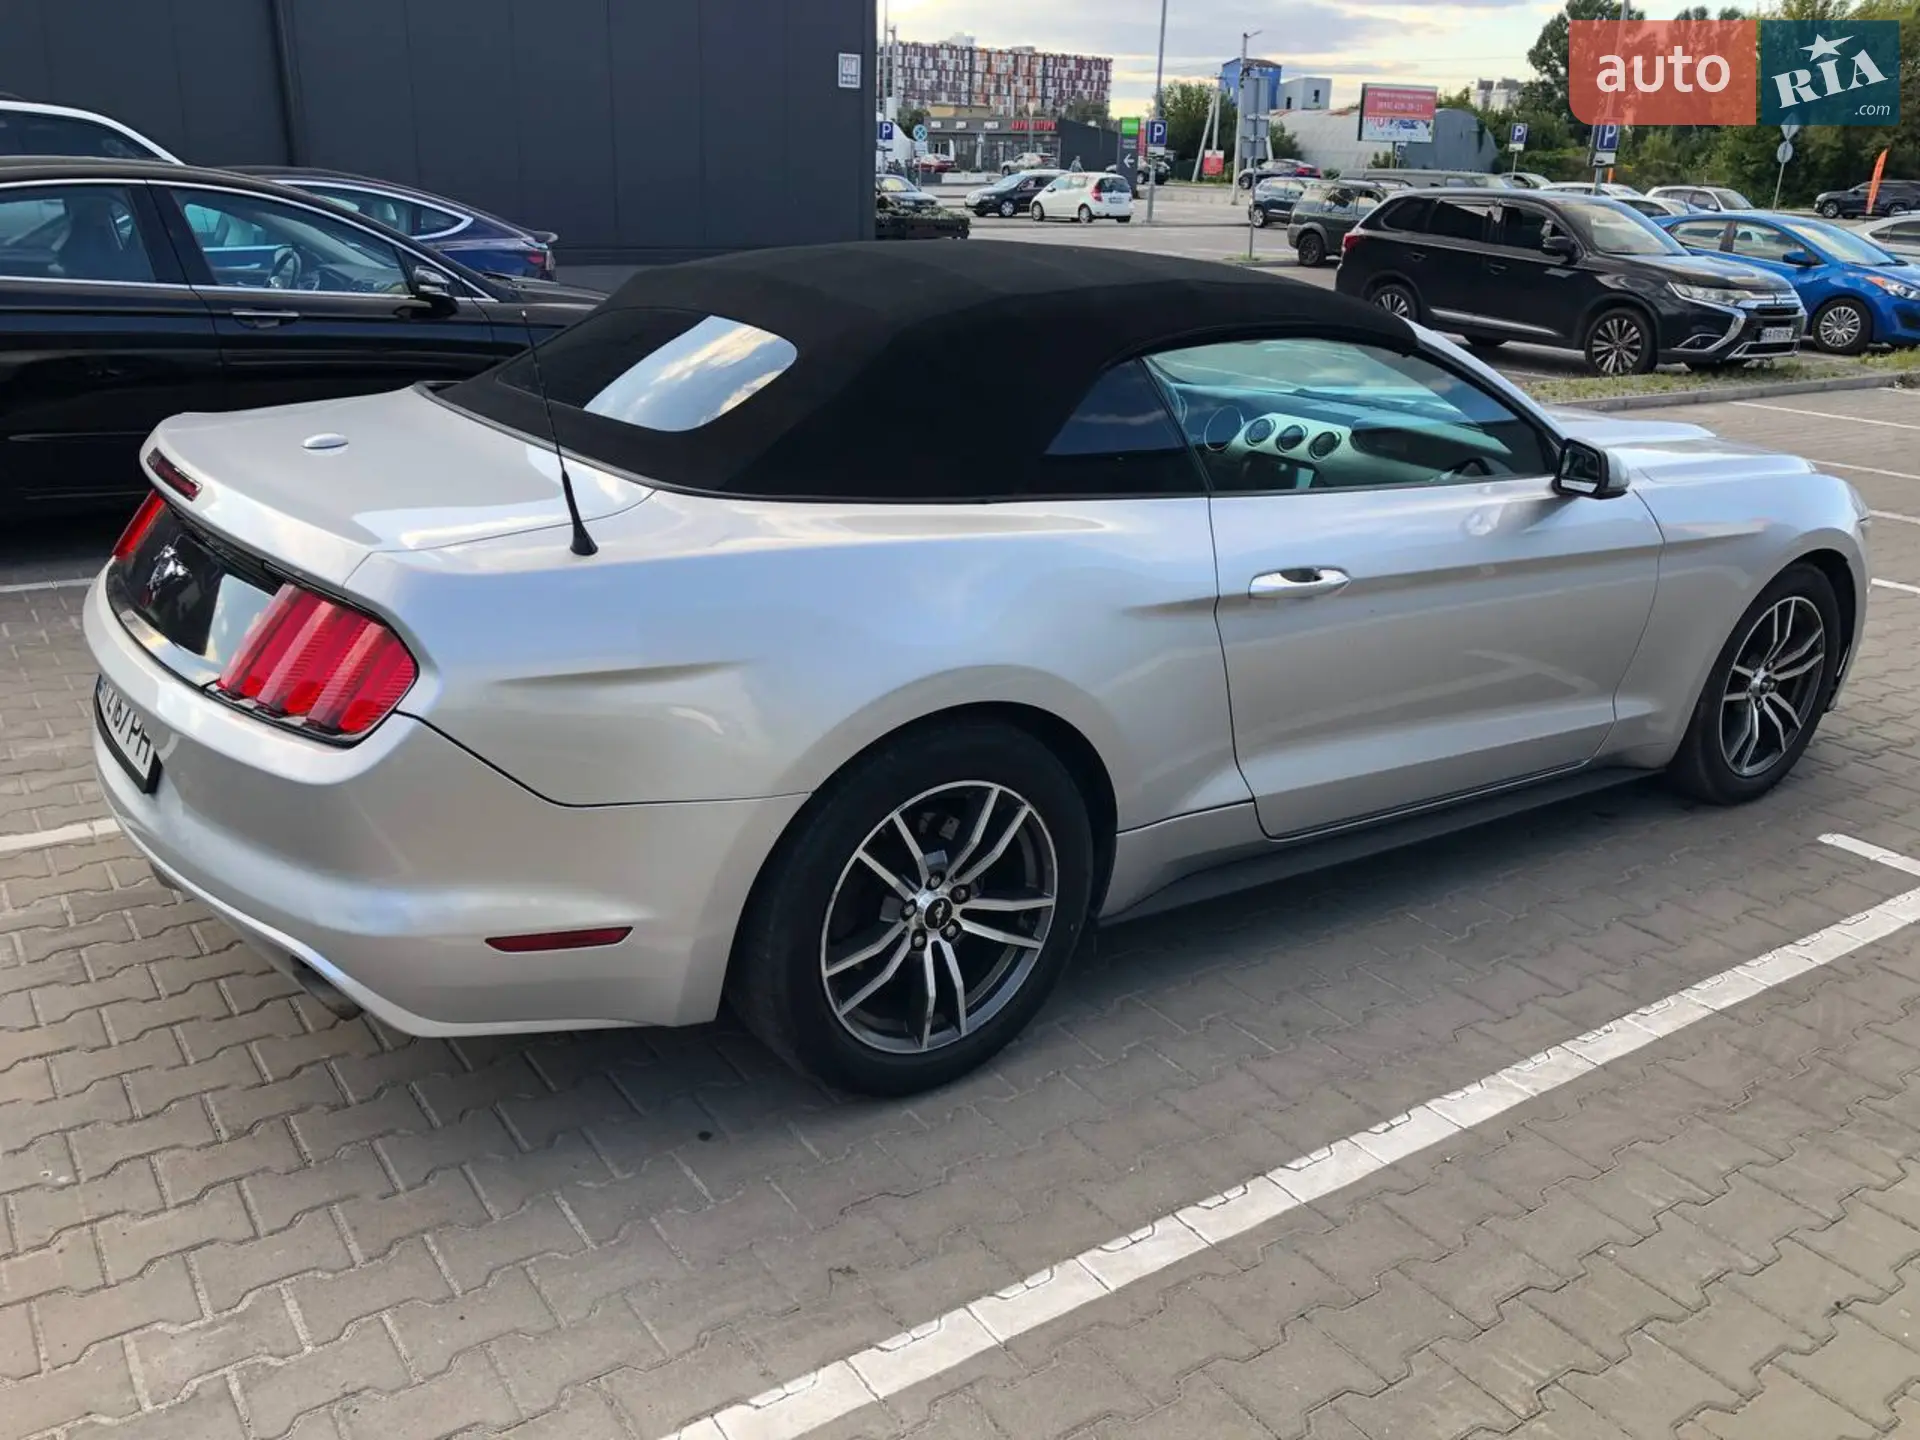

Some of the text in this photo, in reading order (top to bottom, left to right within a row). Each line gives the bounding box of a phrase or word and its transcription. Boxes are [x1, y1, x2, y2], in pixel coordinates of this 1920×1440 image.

[882, 122, 892, 139] P
[1153, 123, 1164, 143] P
[1514, 125, 1524, 140] P
[1603, 121, 1617, 146] P
